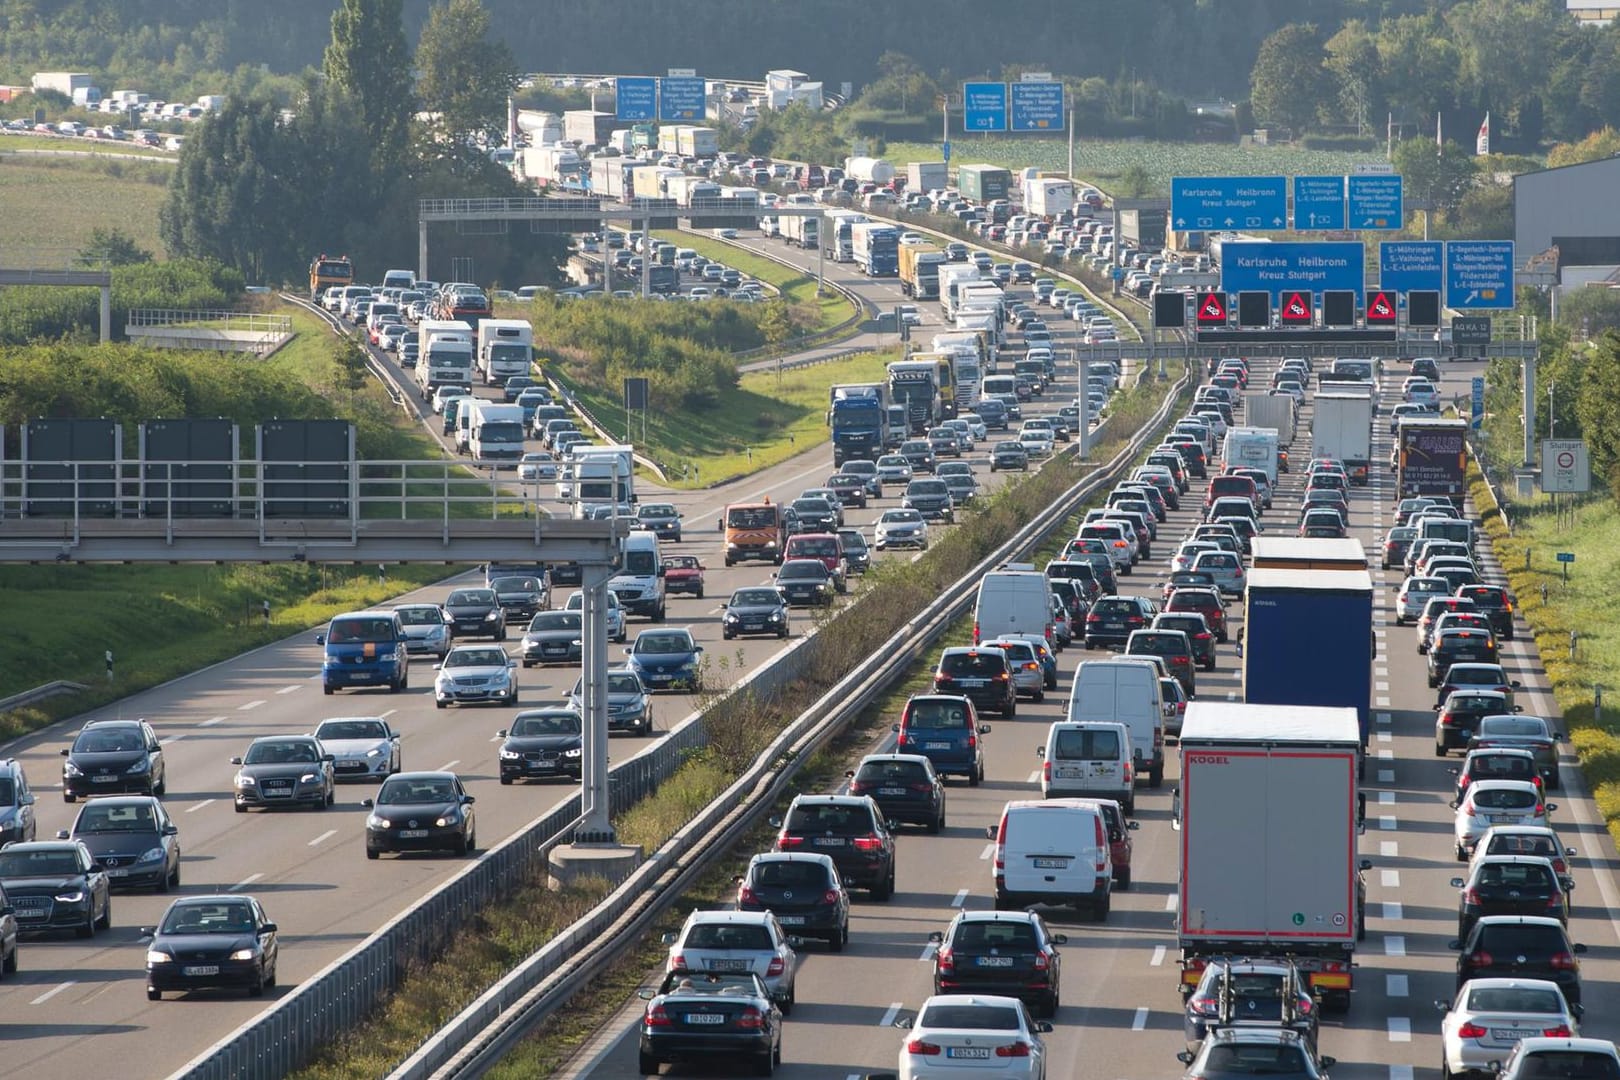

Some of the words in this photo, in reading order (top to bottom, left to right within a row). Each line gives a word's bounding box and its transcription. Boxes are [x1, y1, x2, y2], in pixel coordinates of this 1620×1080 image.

[1182, 189, 1222, 197] Karlsruhe
[1236, 189, 1276, 197] Heilbronn
[1225, 200, 1256, 208] Stuttgart
[1237, 257, 1287, 267] Karlsruhe
[1298, 257, 1347, 267] Heilbronn
[1259, 271, 1285, 280] Kreuz
[1287, 271, 1326, 281] Stuttgart
[1550, 442, 1582, 450] Stuttgart
